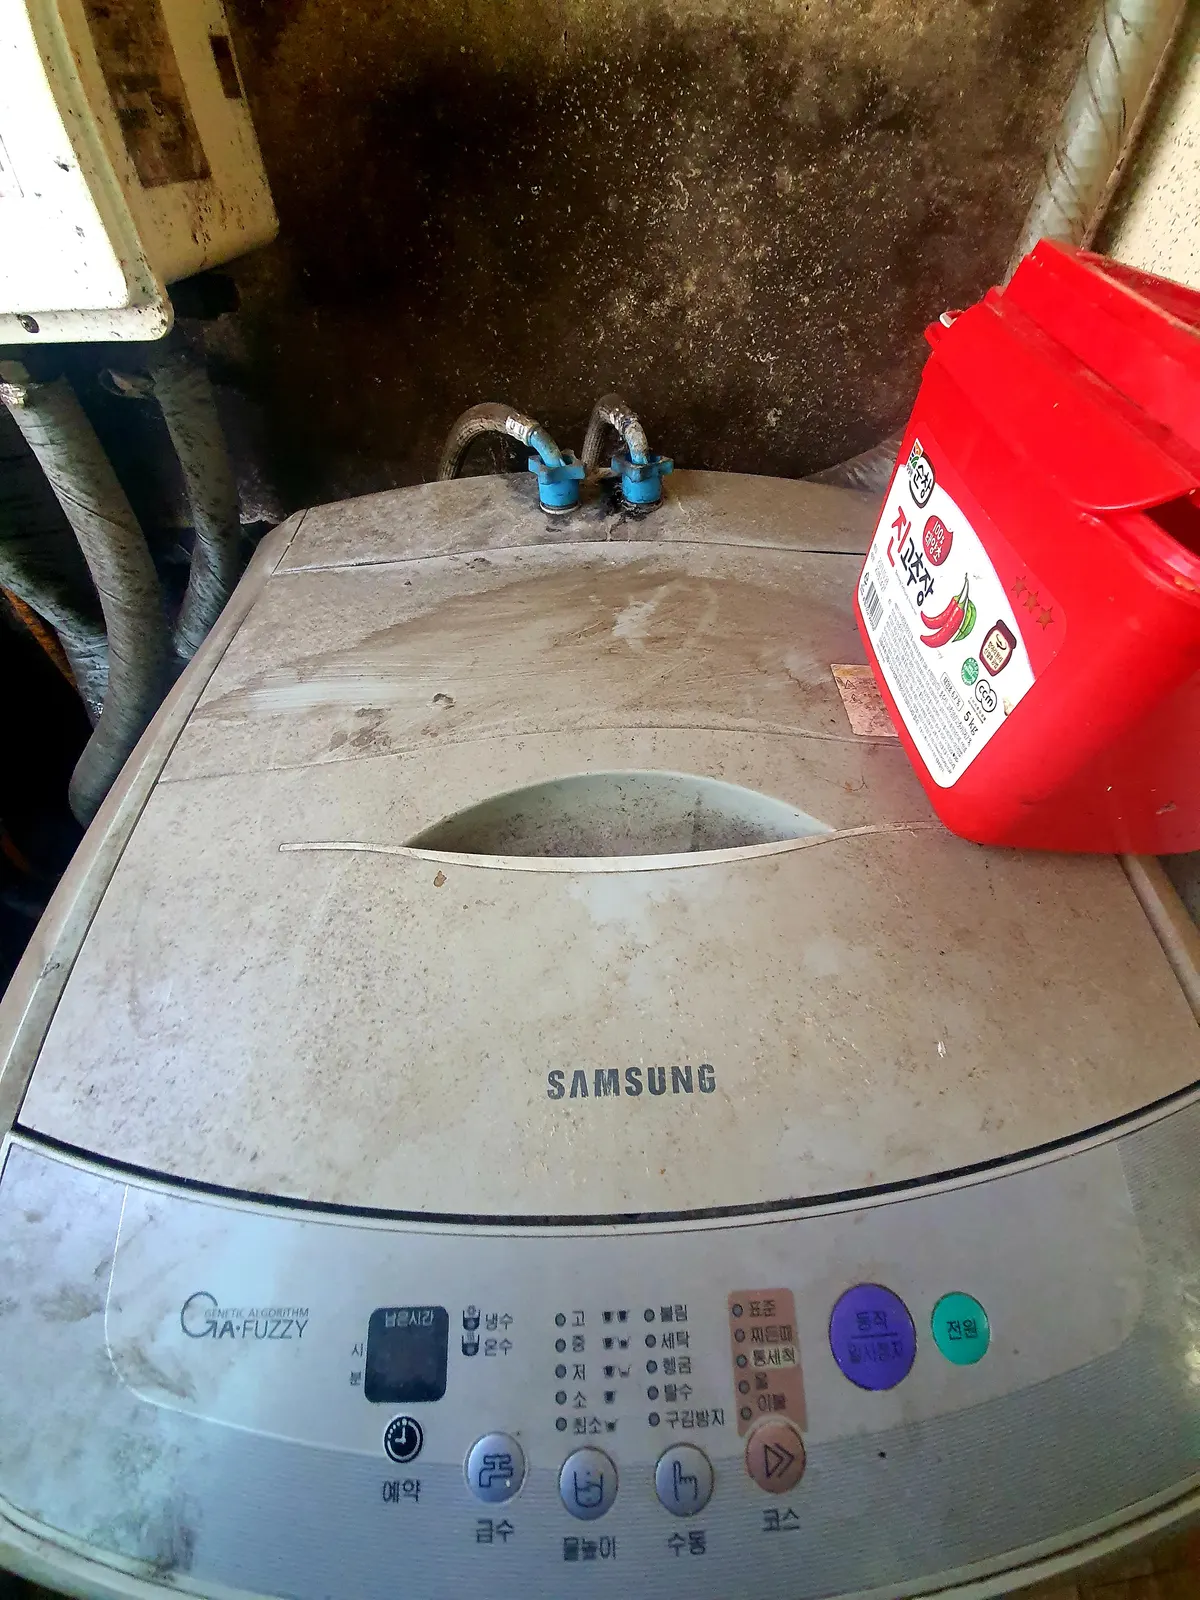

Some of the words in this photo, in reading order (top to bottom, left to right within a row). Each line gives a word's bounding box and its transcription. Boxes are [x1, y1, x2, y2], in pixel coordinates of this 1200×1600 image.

[913, 464, 932, 499] 순창
[924, 530, 942, 563] 태양초
[900, 537, 935, 607] 고추장
[547, 1064, 716, 1100] SAMSUNG
[204, 1307, 244, 1319] GENETIC
[248, 1306, 309, 1318] ALGORITHM
[384, 1310, 435, 1328] 남은시간
[571, 1310, 586, 1328] 고
[749, 1299, 776, 1318] 표준
[485, 1312, 514, 1331] 냉수
[855, 1309, 888, 1331] 동작
[946, 1318, 979, 1341] 전원
[661, 1330, 690, 1350] 세탁
[750, 1323, 793, 1345] 찌든때
[351, 1343, 364, 1358] 시
[484, 1338, 513, 1357] 온수
[751, 1346, 796, 1368] 통세척
[847, 1340, 904, 1365] 일시정지
[572, 1363, 586, 1381] 저
[662, 1355, 692, 1376] 헹굼
[572, 1391, 587, 1409] 소
[664, 1382, 693, 1402] 탈수
[756, 1392, 787, 1413] 이불
[573, 1416, 602, 1435] 최소
[665, 1407, 725, 1429] 구김방지
[382, 1480, 421, 1503] 예약
[475, 1518, 514, 1544] 급수
[763, 1508, 800, 1533] 코스
[563, 1535, 617, 1562] 물높이
[667, 1530, 707, 1556] 수동
